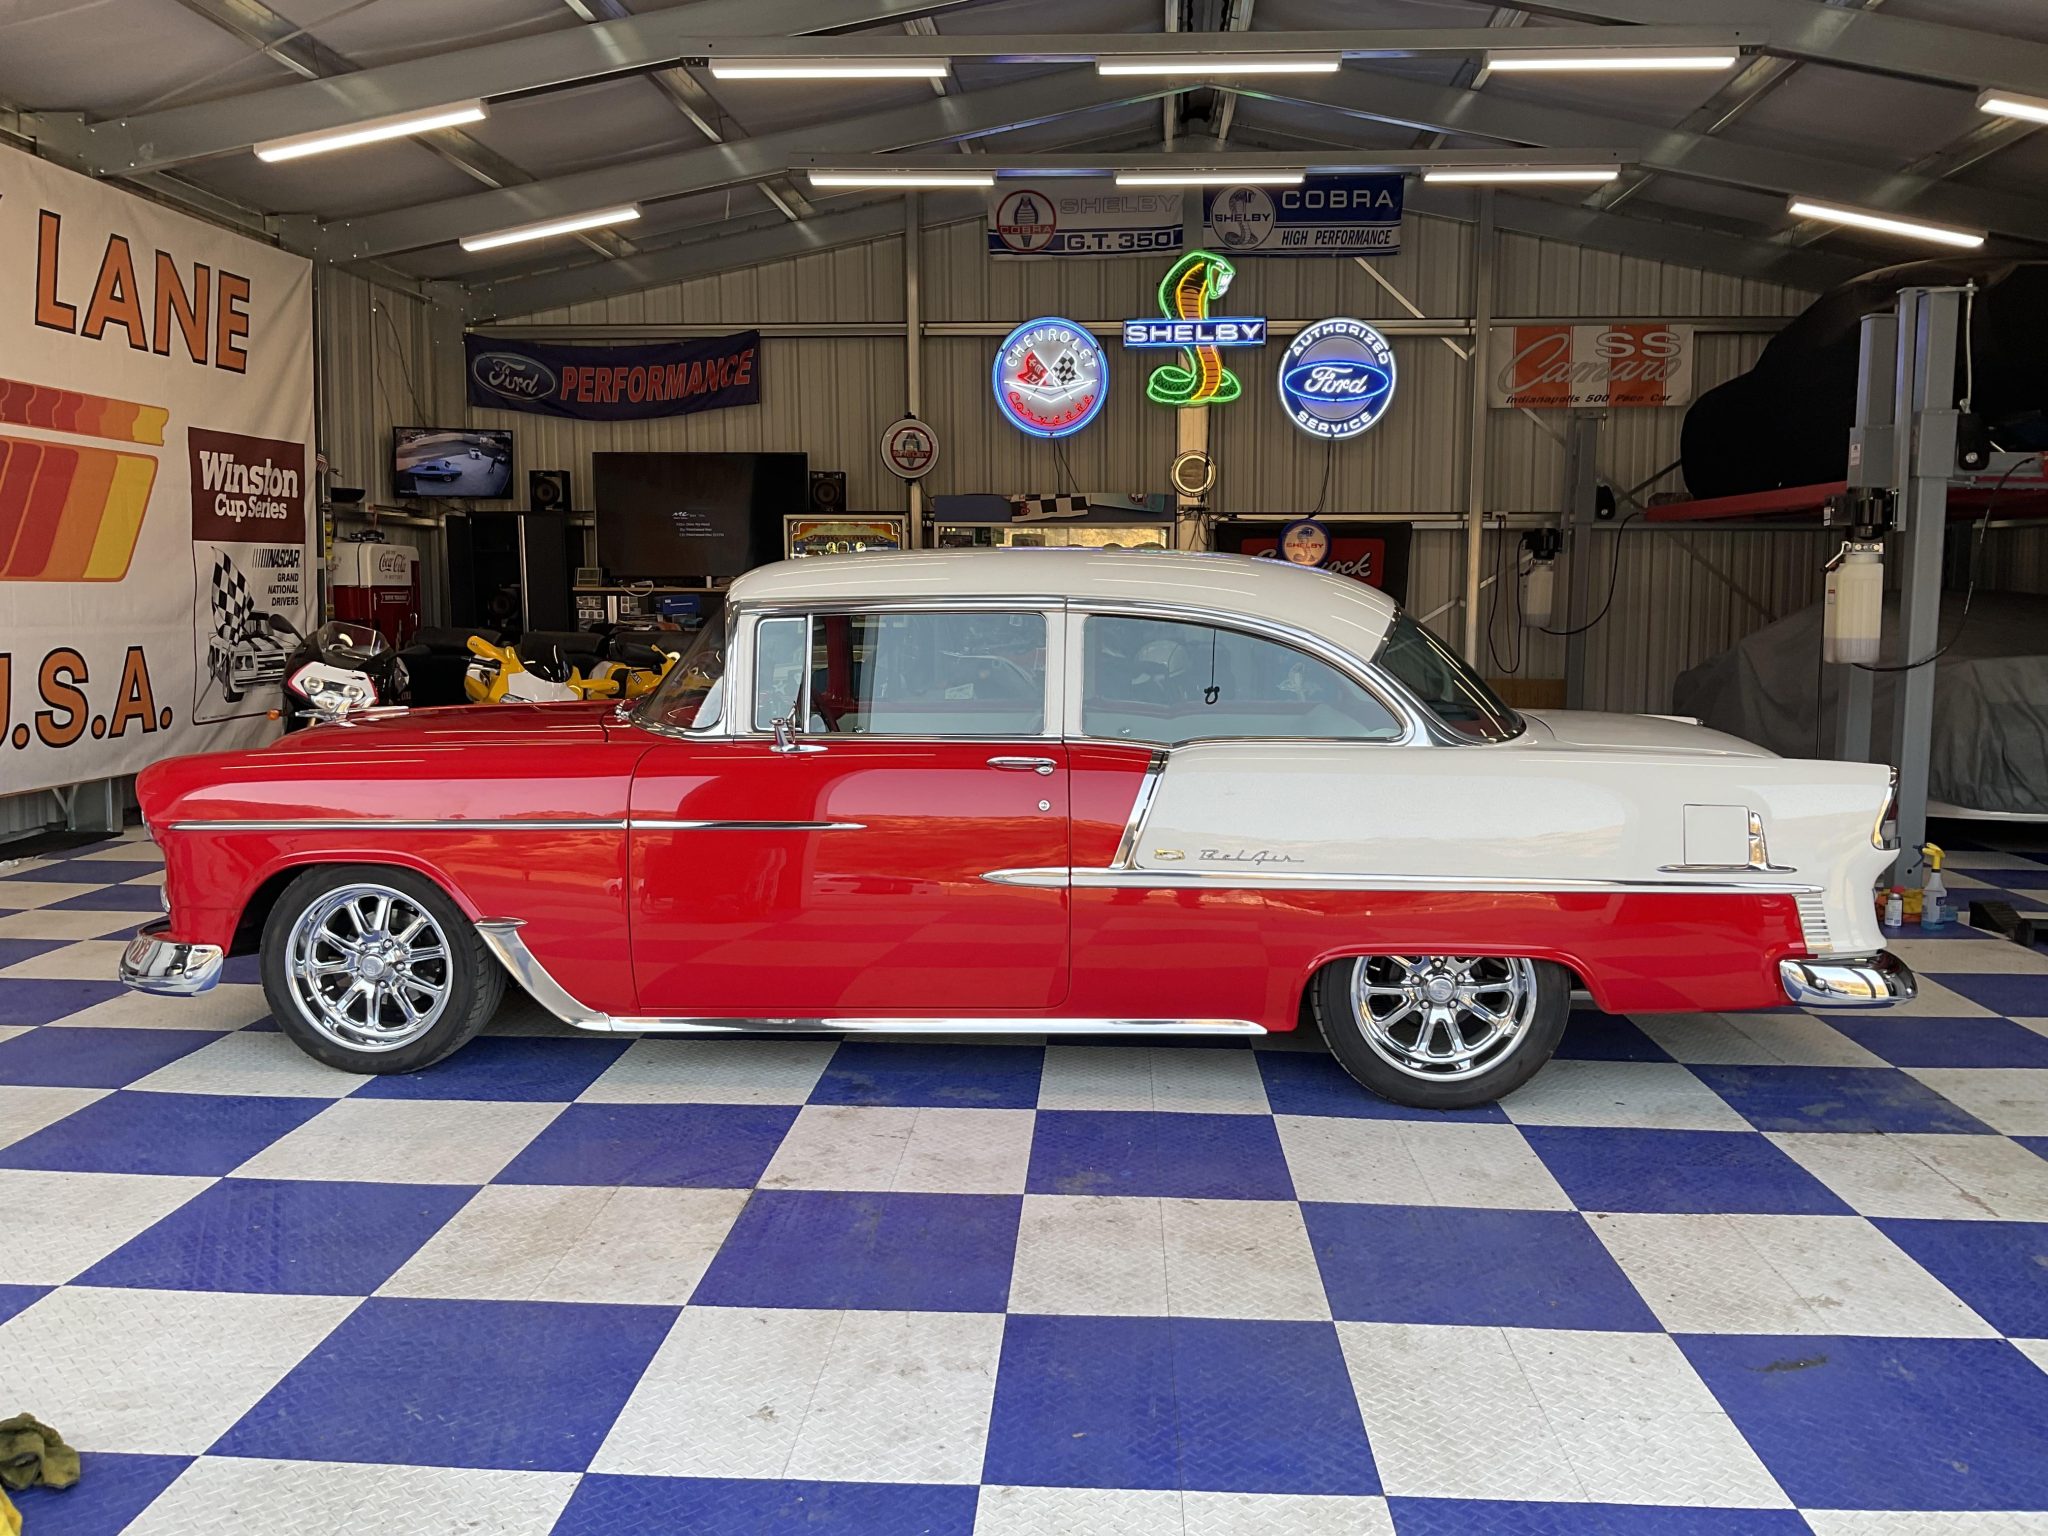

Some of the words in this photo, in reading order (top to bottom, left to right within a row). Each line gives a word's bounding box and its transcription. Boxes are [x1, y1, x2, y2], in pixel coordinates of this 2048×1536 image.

[1060, 194, 1180, 215] SHELBY
[1281, 190, 1394, 209] COBRA
[1215, 213, 1271, 223] SHELBY
[1000, 226, 1053, 235] COBRA
[1066, 234, 1112, 250] G.T.
[1118, 231, 1172, 249] 350
[1281, 230, 1309, 246] HIGH
[1314, 229, 1393, 246] PERFORMANCE
[34, 208, 251, 375] LANE
[1126, 323, 1265, 343] SHELBY
[1006, 327, 1096, 368] CHEVROLET
[1293, 323, 1389, 366] AUTHORIZED
[1595, 331, 1682, 358] SS
[1497, 332, 1682, 395] Camaro
[488, 358, 539, 395] Ford
[560, 348, 755, 403] PERFORMANCE
[1304, 366, 1369, 394] Ford
[1008, 391, 1094, 427] Corvette
[1506, 395, 1580, 404] Indianapolis
[1585, 394, 1609, 403] 500
[1615, 394, 1645, 402] Pace
[1650, 393, 1672, 401] Car
[1297, 410, 1373, 433] SERVICE
[199, 450, 299, 498] Winston
[214, 493, 247, 523] Cup
[248, 495, 287, 520] Series
[268, 549, 300, 568] NASCAR
[277, 572, 299, 582] GRAND
[267, 584, 299, 594] NATIONAL
[271, 596, 299, 606] DRIVERS
[0, 645, 173, 750] .S.A.
[1199, 849, 1250, 862] Bel
[1251, 850, 1305, 866] Air
